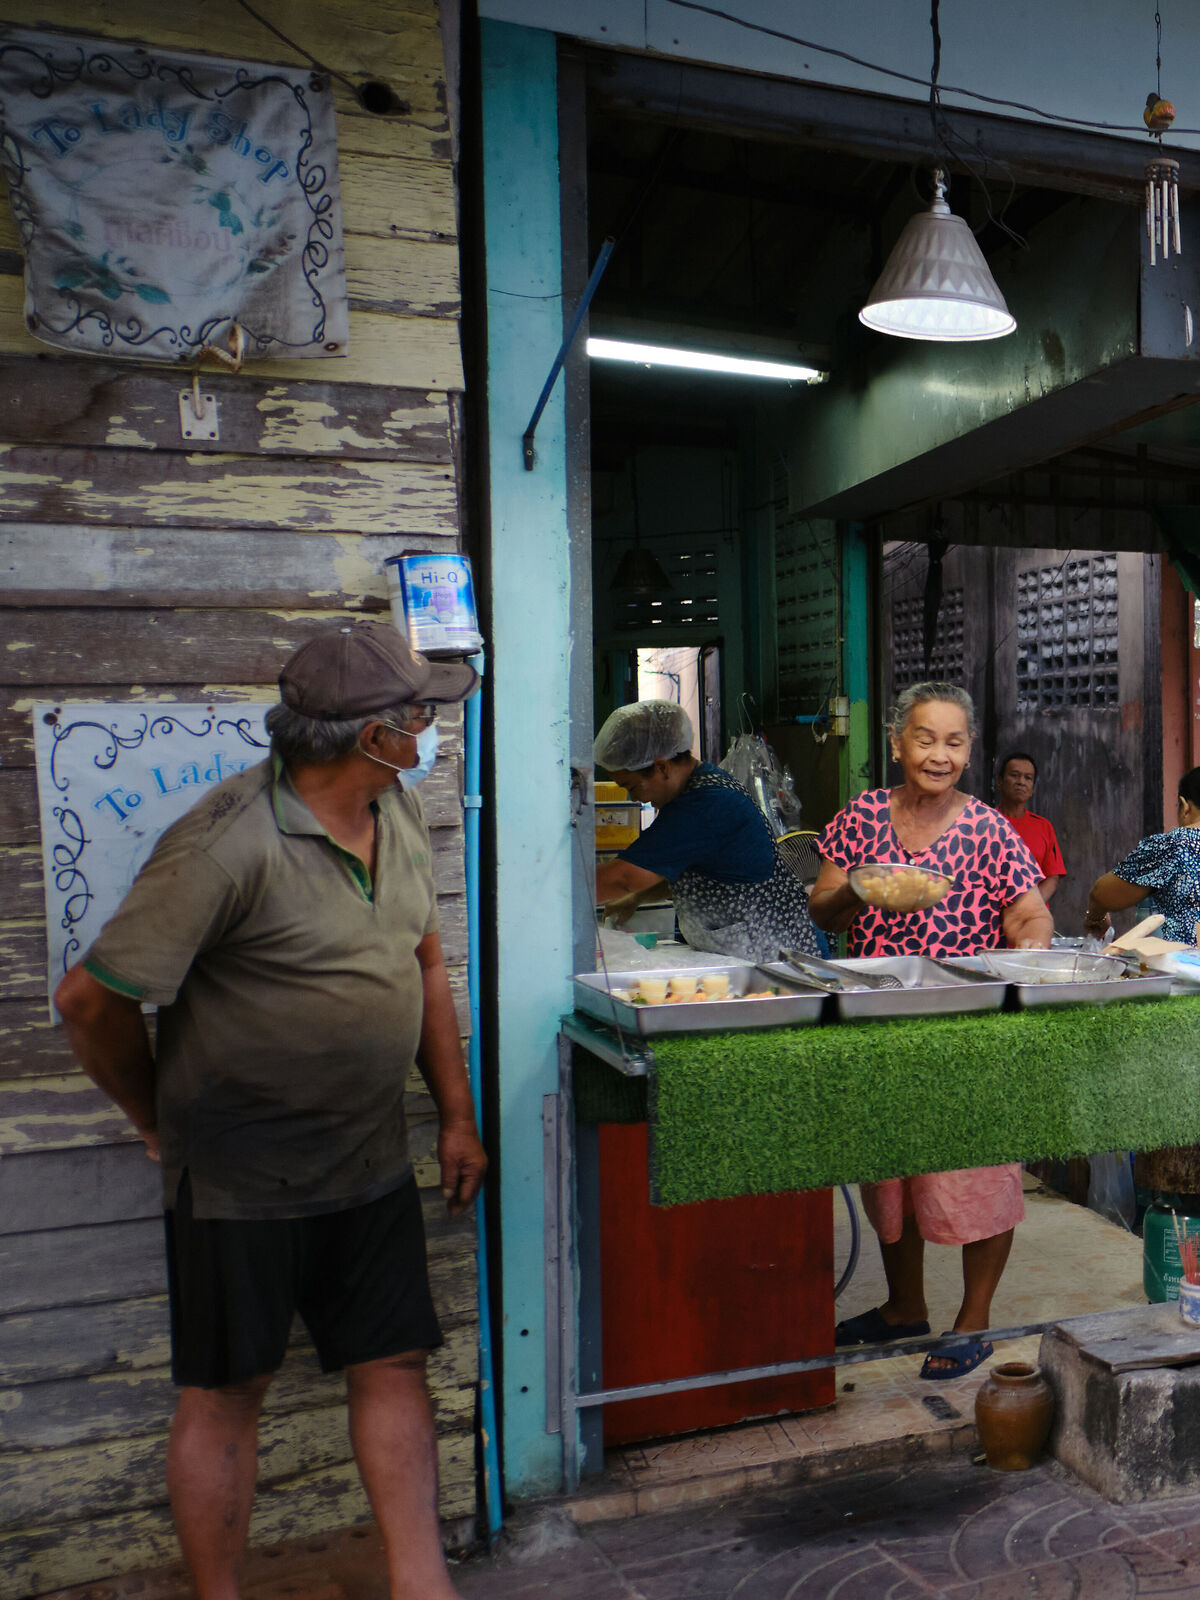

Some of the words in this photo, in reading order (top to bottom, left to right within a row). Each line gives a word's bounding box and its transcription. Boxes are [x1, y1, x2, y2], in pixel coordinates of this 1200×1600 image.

[31, 116, 82, 155] To
[91, 99, 190, 143] Lady
[206, 110, 290, 184] Shop
[421, 571, 458, 584] Hi-Q
[93, 786, 143, 823] To
